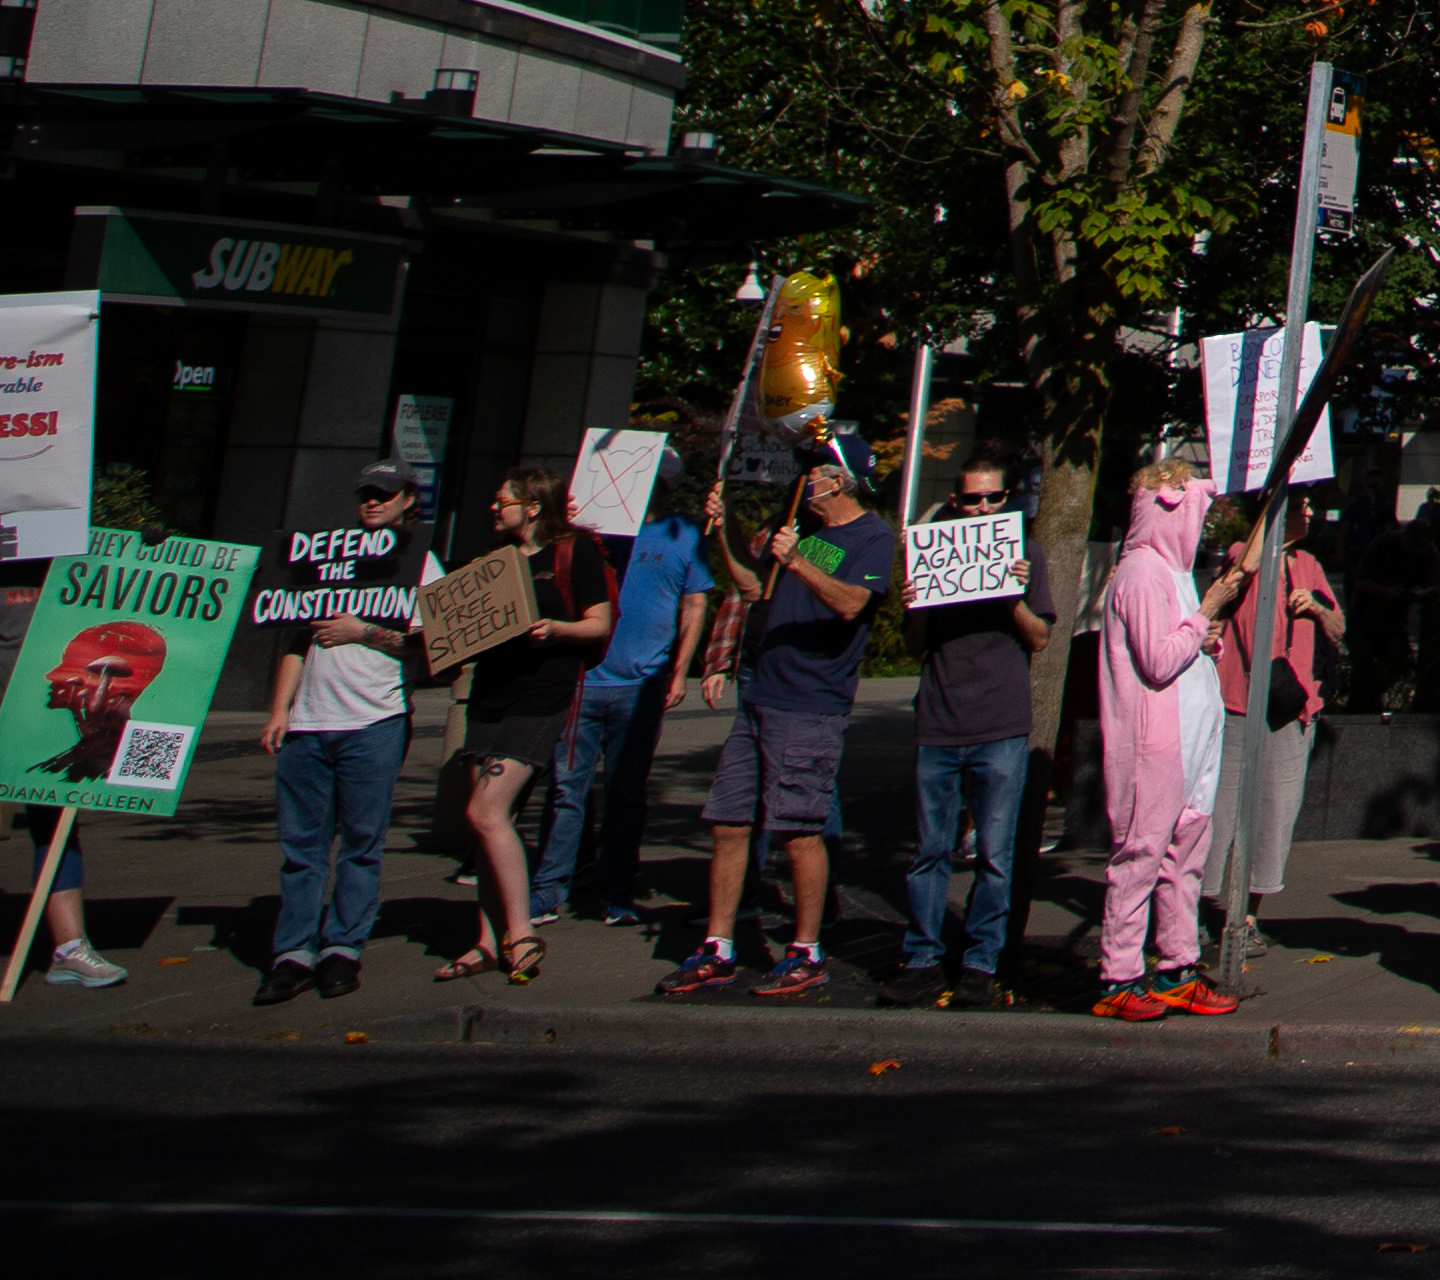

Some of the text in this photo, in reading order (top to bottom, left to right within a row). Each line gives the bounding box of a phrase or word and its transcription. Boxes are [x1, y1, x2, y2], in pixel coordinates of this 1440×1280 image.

[191, 237, 354, 298] SUBWAY
[1230, 336, 1283, 362] BOYCO
[1230, 358, 1283, 389] DISNE
[88, 529, 134, 559] HEY
[212, 545, 242, 573] BE
[288, 526, 399, 564] DEFEND
[912, 519, 1011, 551] UNITE
[316, 559, 357, 582] THE
[911, 539, 1021, 575] AGAINST
[60, 560, 230, 622] SAVIORS
[253, 584, 417, 626] CONSTITUTION
[425, 557, 506, 620] DEFEND
[443, 589, 496, 632] FREE
[429, 598, 520, 666] SPEECH
[0, 782, 155, 813] DIANA COLLEEN
